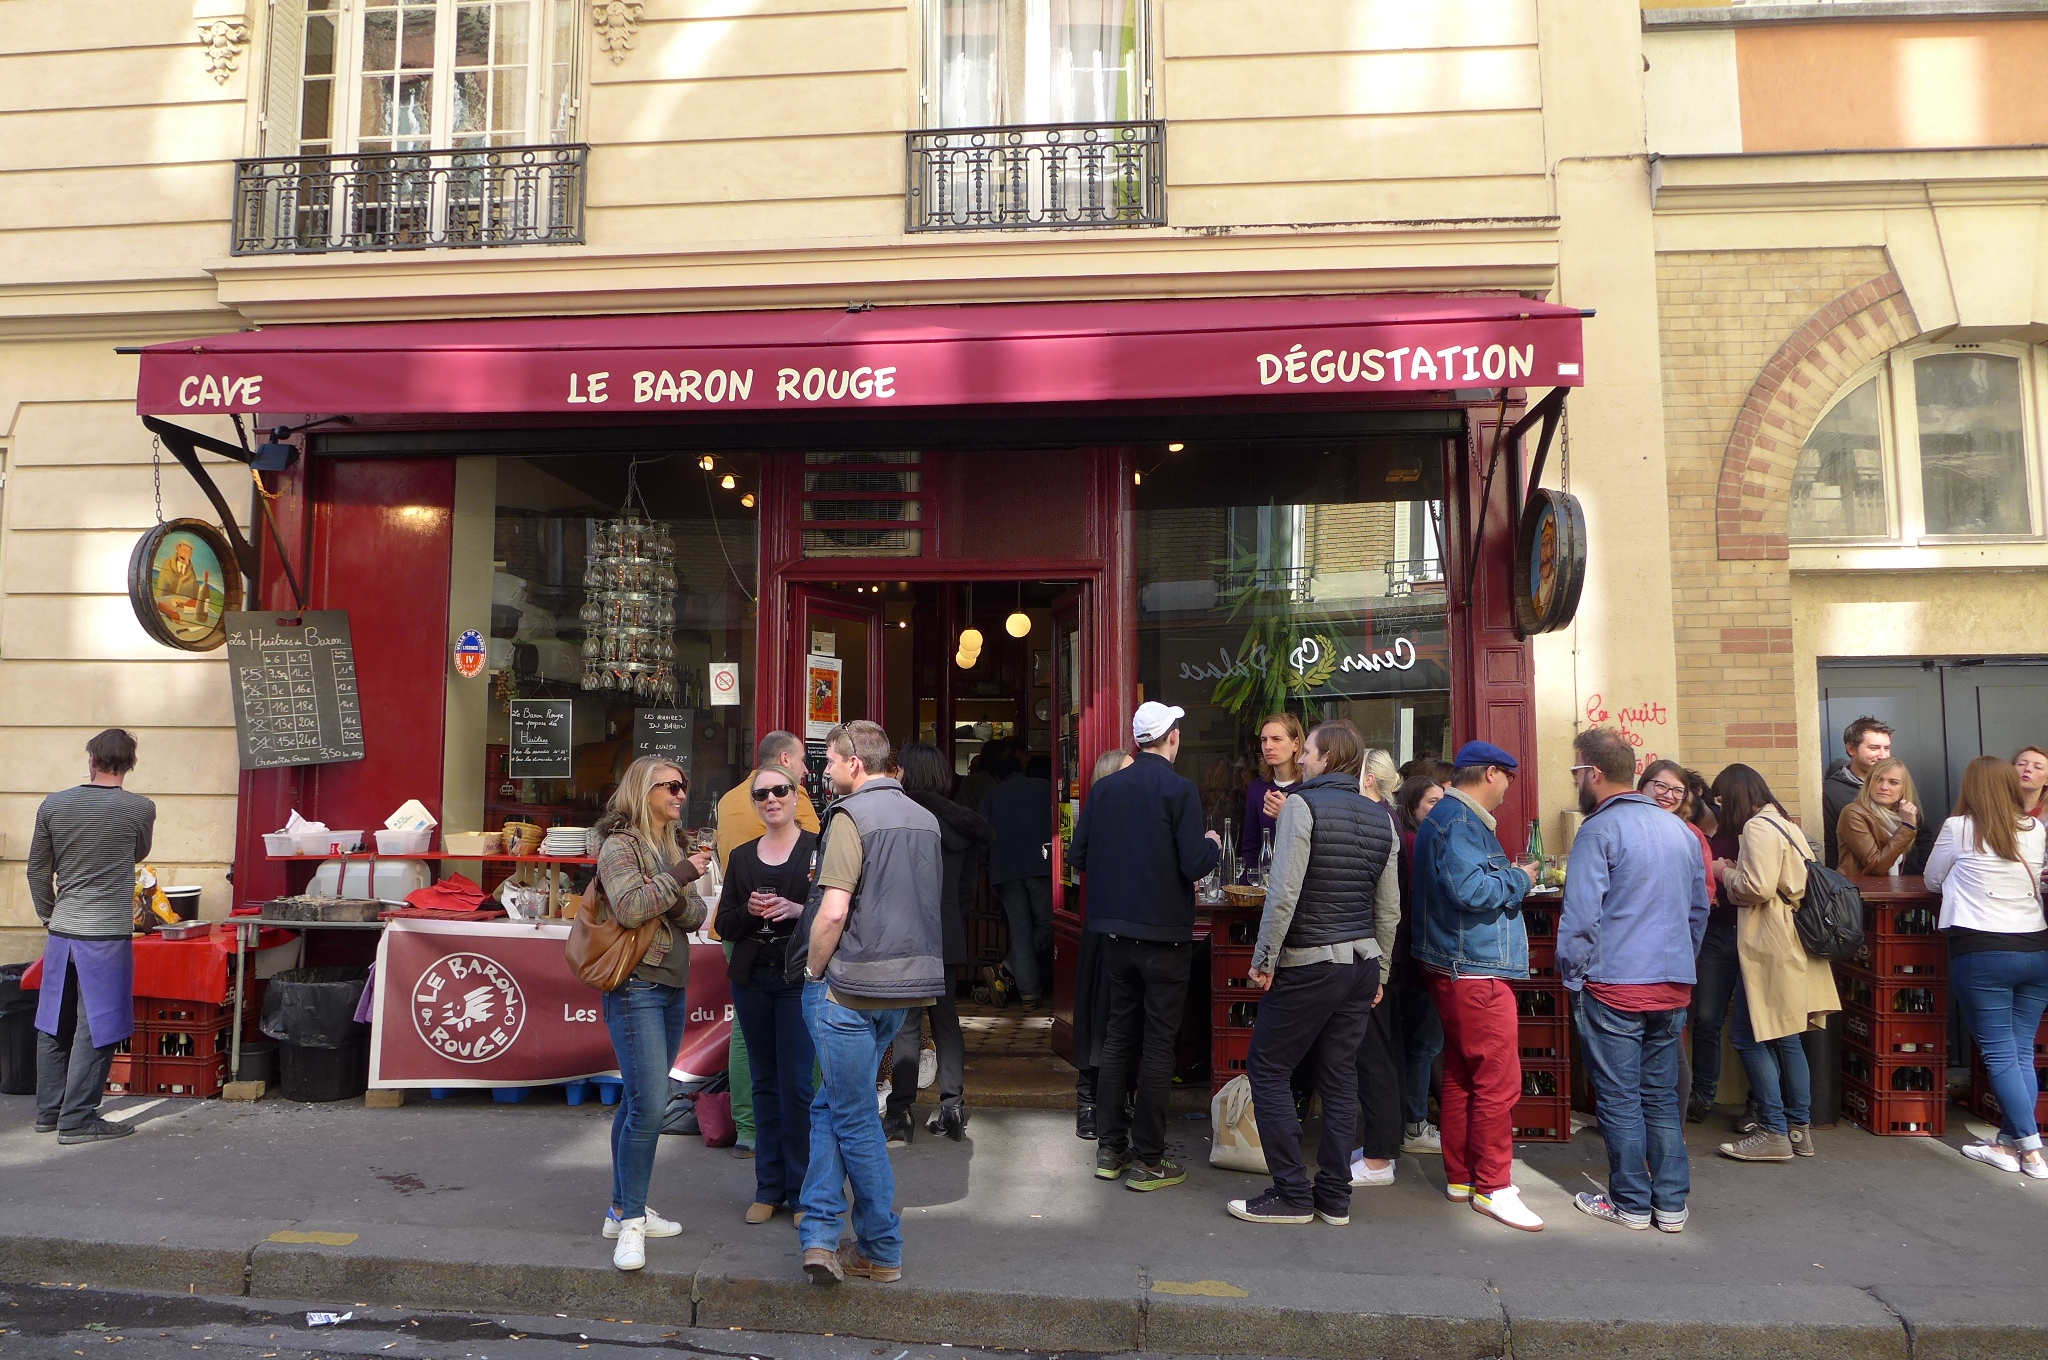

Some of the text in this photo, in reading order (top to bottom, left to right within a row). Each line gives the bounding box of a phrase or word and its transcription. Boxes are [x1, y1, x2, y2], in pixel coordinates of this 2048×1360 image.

[1256, 343, 1534, 385] DÉGUSTATION
[179, 374, 264, 408] CAVE
[567, 366, 897, 404] LE BARON ROUGE
[228, 631, 247, 646] Les
[304, 626, 346, 647] Baron
[465, 655, 475, 664] IV
[1617, 702, 1667, 726] nuit
[417, 957, 519, 1006] LE BARON
[564, 1003, 597, 1023] Les
[690, 1006, 715, 1023] du
[429, 1025, 509, 1058] ROUGE
